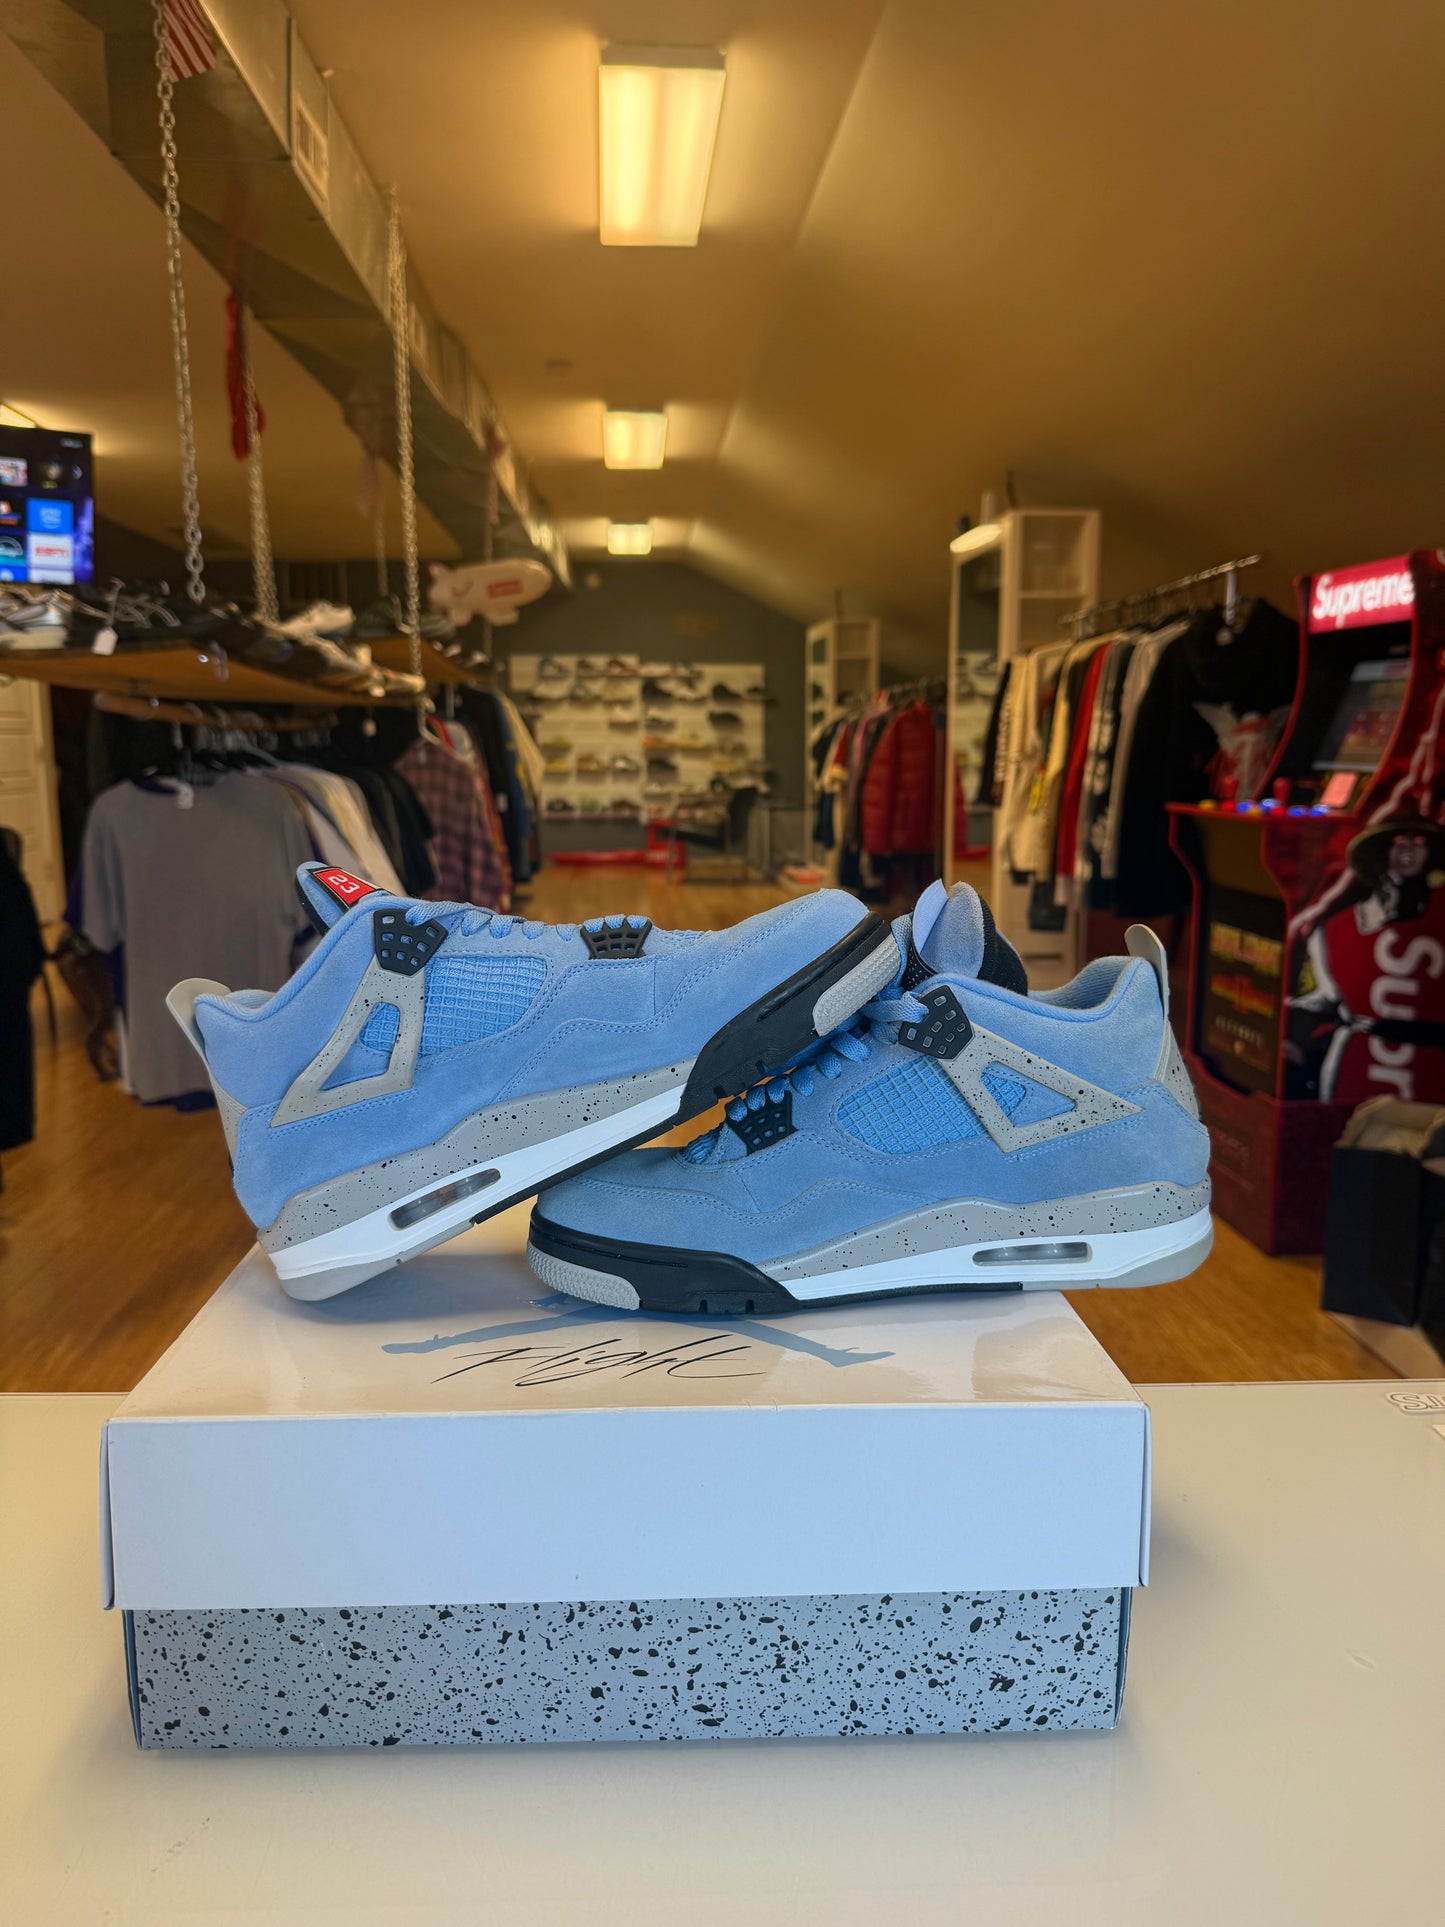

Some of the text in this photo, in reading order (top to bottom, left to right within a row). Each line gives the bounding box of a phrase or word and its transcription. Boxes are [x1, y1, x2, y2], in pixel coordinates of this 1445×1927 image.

[1313, 573, 1415, 628] Supreme
[328, 874, 360, 894] 23
[430, 1333, 767, 1387] Flight
